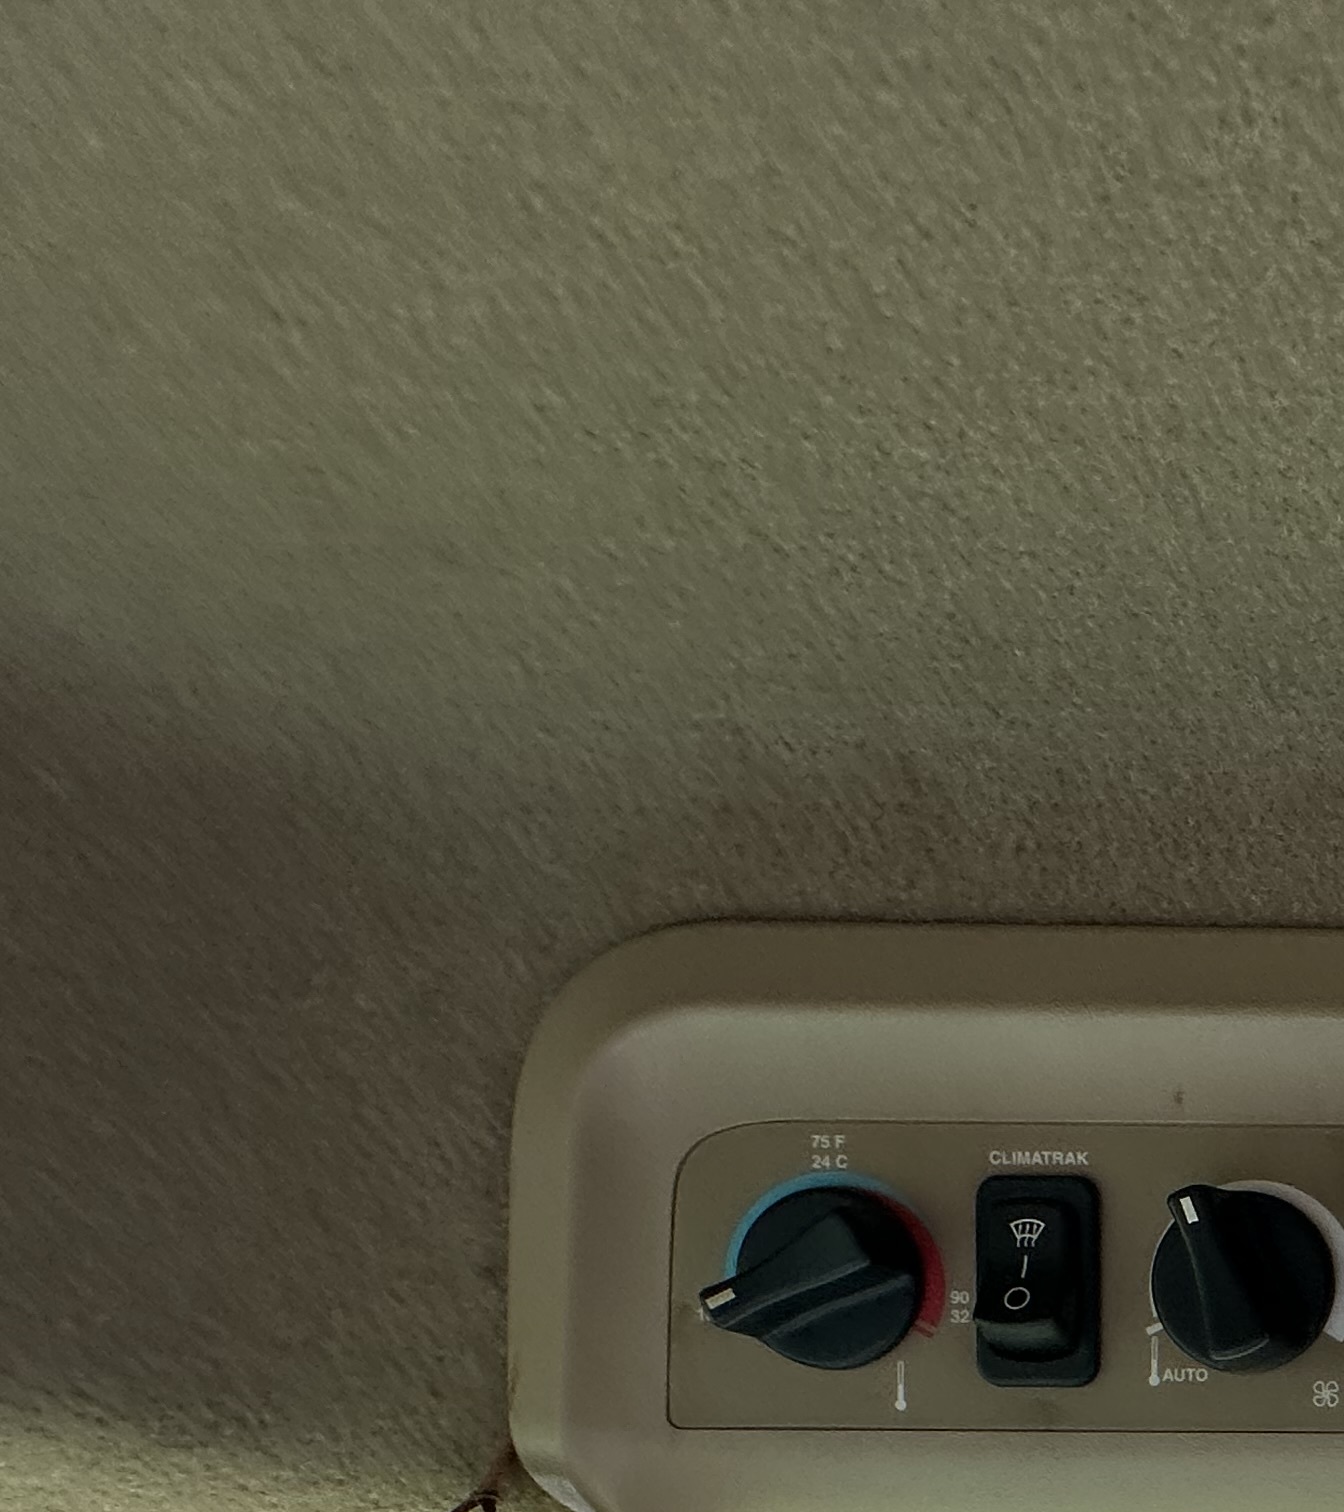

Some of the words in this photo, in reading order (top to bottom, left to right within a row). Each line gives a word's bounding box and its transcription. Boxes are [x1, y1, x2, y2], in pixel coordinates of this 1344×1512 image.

[811, 1135, 831, 1149] 75
[835, 1135, 846, 1149] F
[811, 1154, 831, 1169] 24
[835, 1154, 848, 1169] C
[989, 1150, 1089, 1166] CLIMATRAK
[950, 1290, 970, 1305] 90
[950, 1309, 970, 1324] 32
[1162, 1367, 1208, 1382] AUTO
